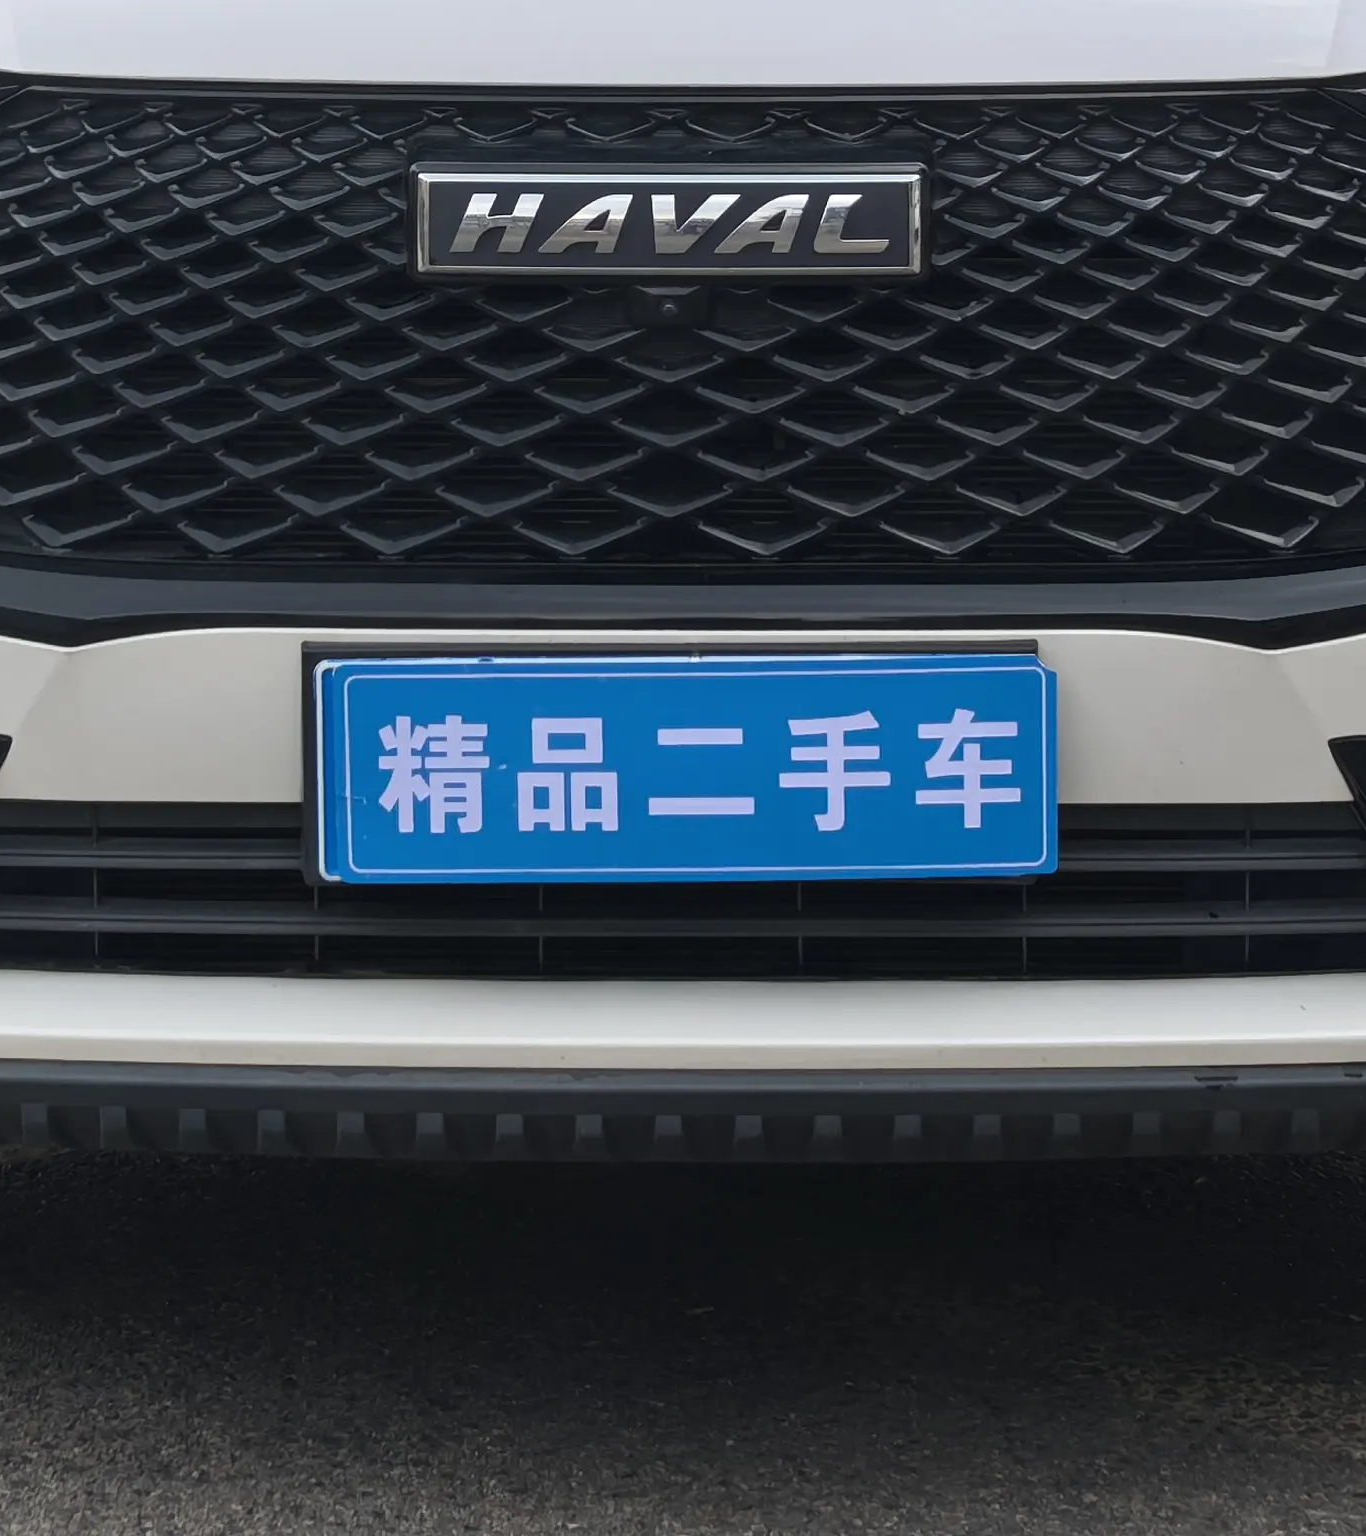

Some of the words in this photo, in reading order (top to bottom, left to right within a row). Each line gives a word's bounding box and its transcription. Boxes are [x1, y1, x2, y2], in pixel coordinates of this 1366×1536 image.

[449, 193, 890, 254] HAVAL
[378, 709, 1022, 834] 精品二手车
